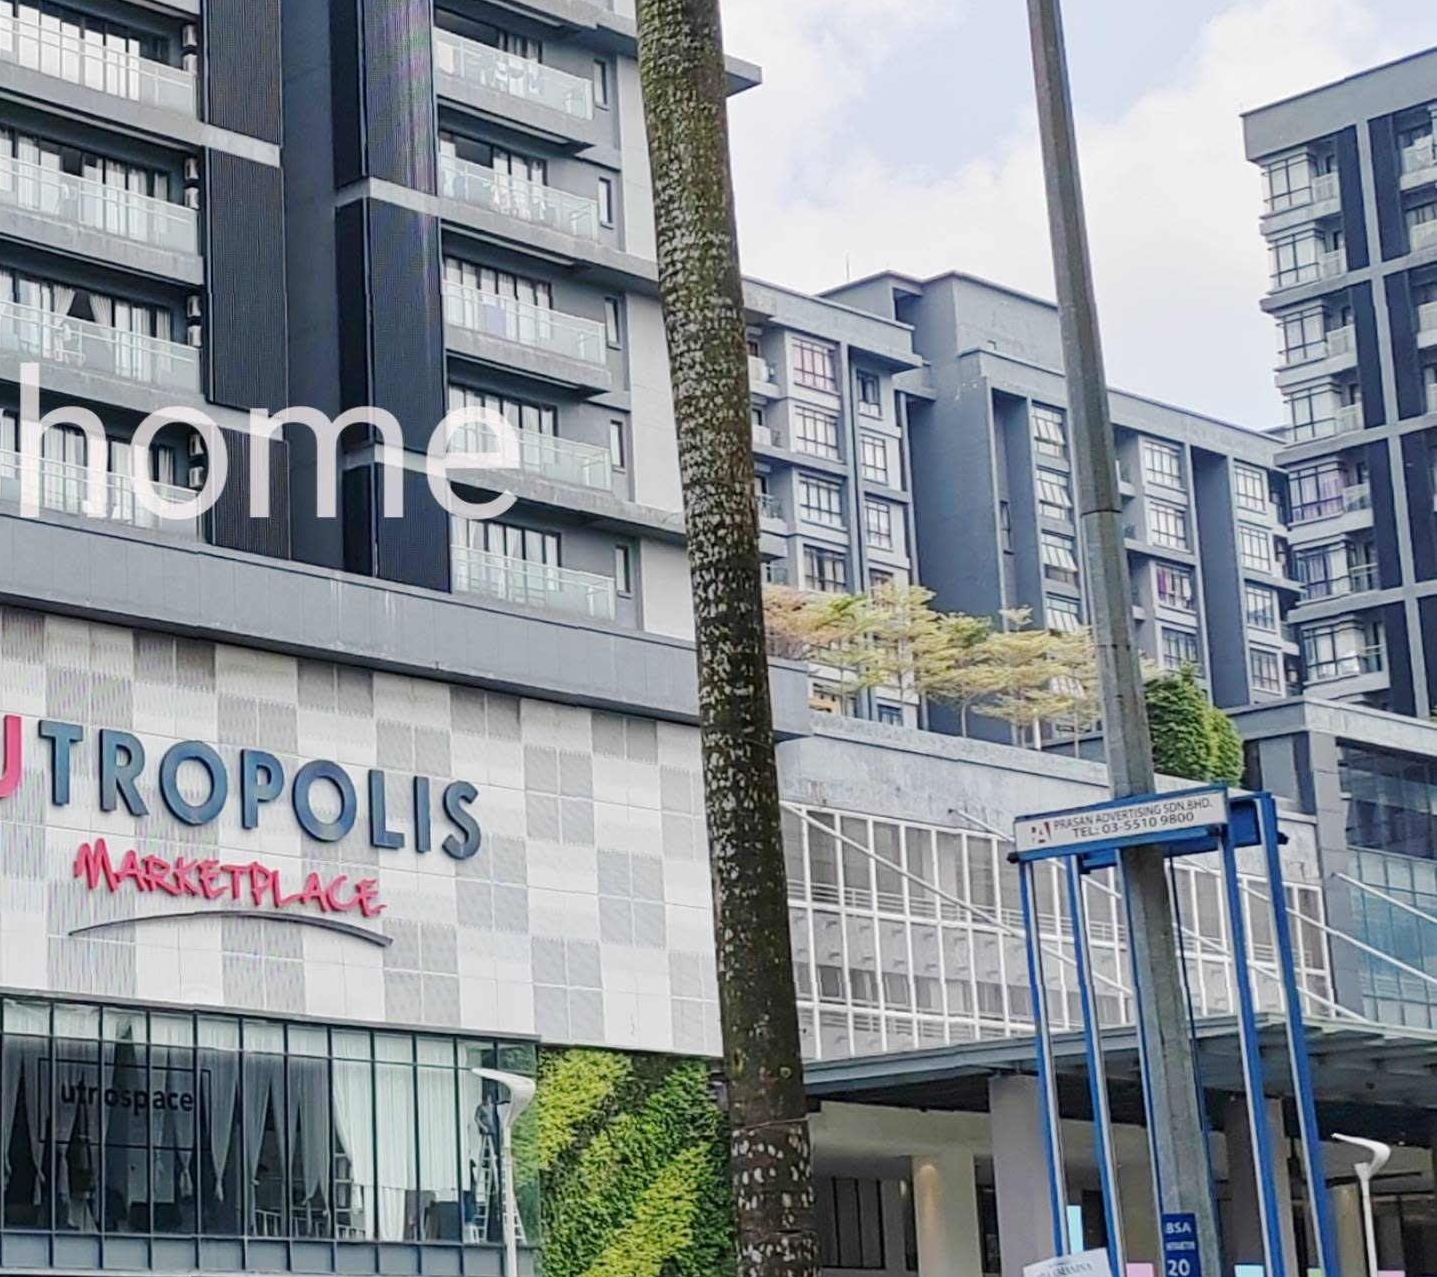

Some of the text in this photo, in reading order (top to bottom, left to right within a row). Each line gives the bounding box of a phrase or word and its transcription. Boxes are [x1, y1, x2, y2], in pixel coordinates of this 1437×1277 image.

[1054, 815, 1093, 830] PRASAN
[1095, 805, 1162, 825] ADVERTISING
[1074, 812, 1194, 838] TEL: 03-5510 9800
[74, 838, 388, 917] MARKETPLACE
[61, 1080, 194, 1116] utrospace
[1166, 1222, 1192, 1234] BSA
[1167, 1258, 1191, 1277] 20
